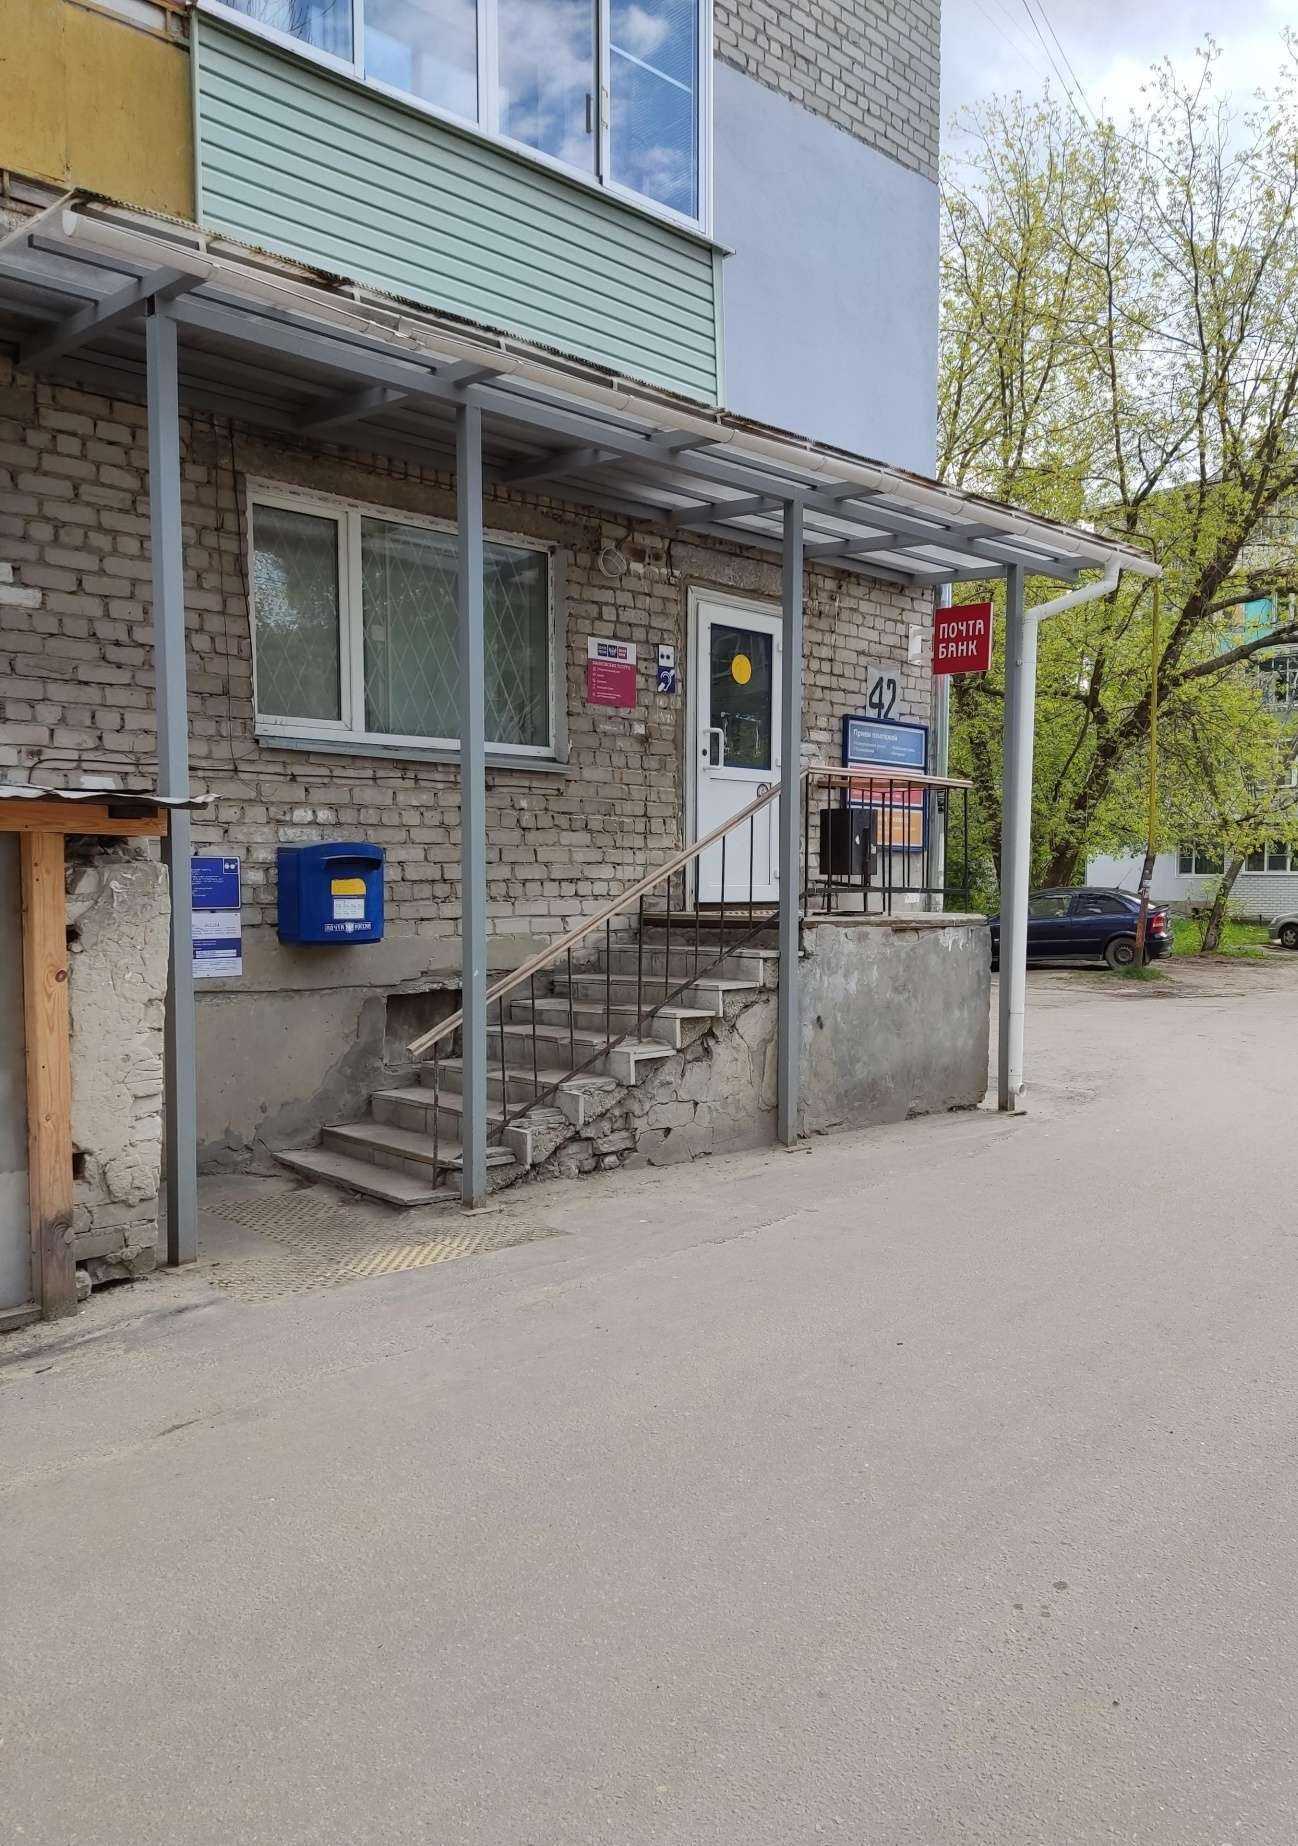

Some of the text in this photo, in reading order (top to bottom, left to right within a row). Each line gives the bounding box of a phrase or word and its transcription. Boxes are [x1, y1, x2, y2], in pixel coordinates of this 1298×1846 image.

[939, 619, 985, 640] ПОЧТА
[938, 640, 978, 660] БАНК
[868, 676, 897, 719] 42
